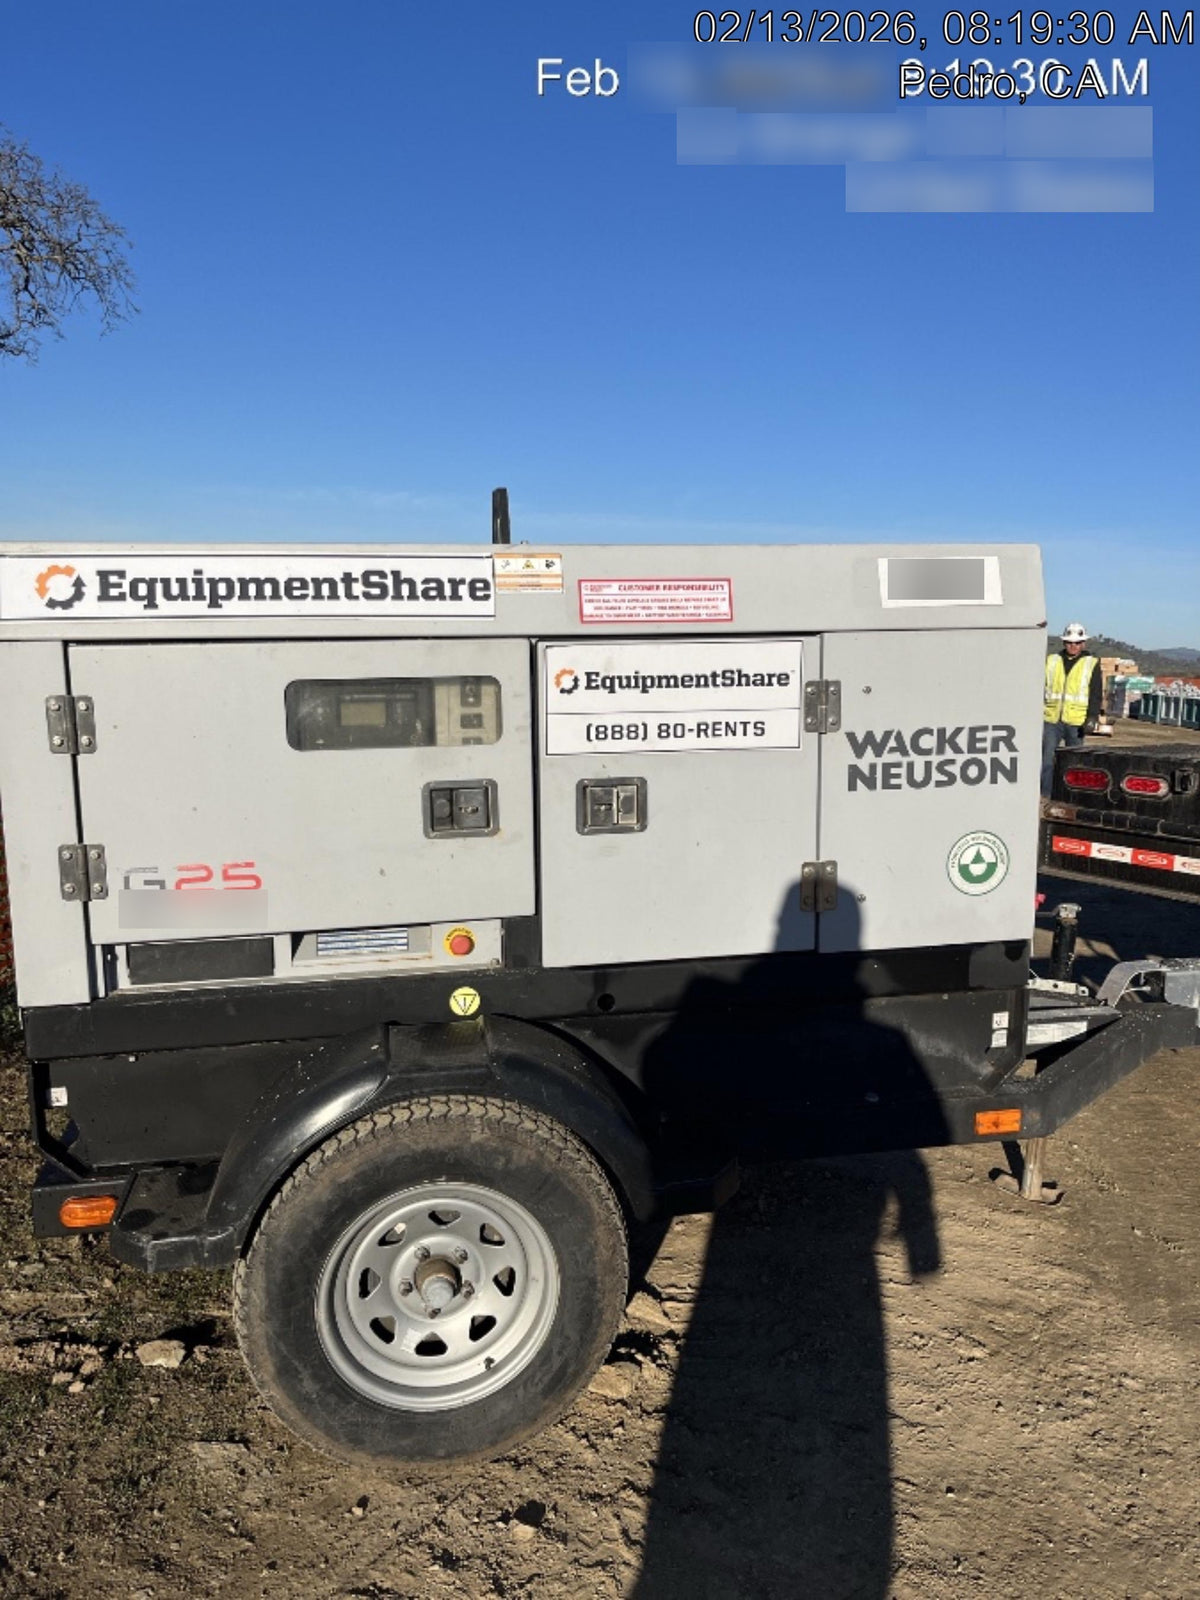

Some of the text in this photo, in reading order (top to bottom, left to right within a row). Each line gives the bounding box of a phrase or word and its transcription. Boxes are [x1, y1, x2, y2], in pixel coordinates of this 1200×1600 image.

[96, 569, 491, 609] EquipmentShare
[585, 669, 791, 694] EquipmentShare
[586, 721, 766, 742] (888) 80-RENTS
[845, 725, 1020, 760] WACKER
[848, 757, 1018, 792] NEUSON
